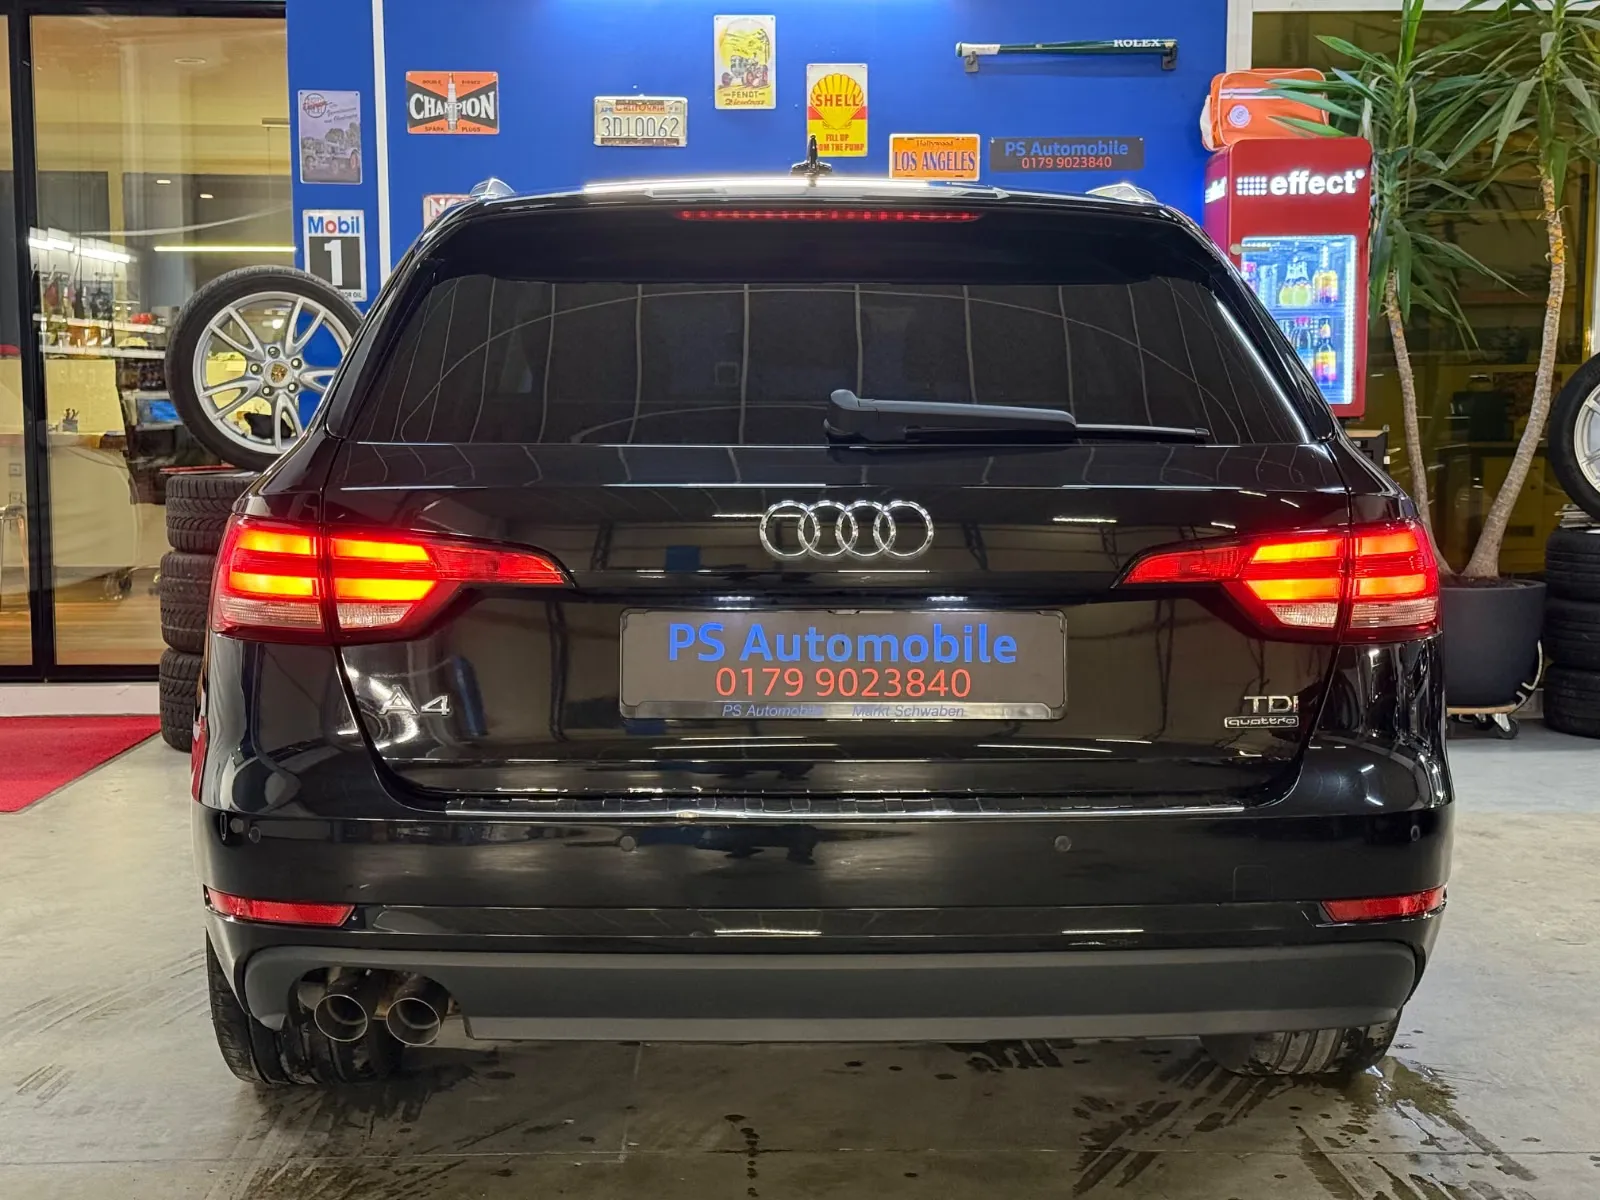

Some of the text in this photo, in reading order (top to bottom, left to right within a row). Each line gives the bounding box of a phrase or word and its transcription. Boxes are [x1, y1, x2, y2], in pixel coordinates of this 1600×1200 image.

[1113, 39, 1162, 48] ROLEX
[409, 91, 496, 120] CHAMPION
[614, 104, 665, 112] CALIFORNIA
[815, 94, 860, 107] SHELL
[825, 133, 850, 142] FILL UP
[831, 143, 844, 151] THE
[845, 143, 865, 151] PUMP
[1004, 140, 1129, 157] PS Automobile
[894, 151, 976, 171] LOS ANGELES
[1021, 156, 1112, 169] 0179 9023840
[1269, 169, 1357, 196] effect
[307, 216, 360, 234] Mobil
[324, 239, 343, 286] 1
[669, 622, 1018, 664] PS Automobile
[715, 667, 971, 698] 0179 9023840
[379, 684, 451, 716] A4
[1243, 695, 1299, 713] TDI
[722, 704, 965, 718] PS Automobile Markt Schwaben
[1228, 717, 1296, 726] quattro
